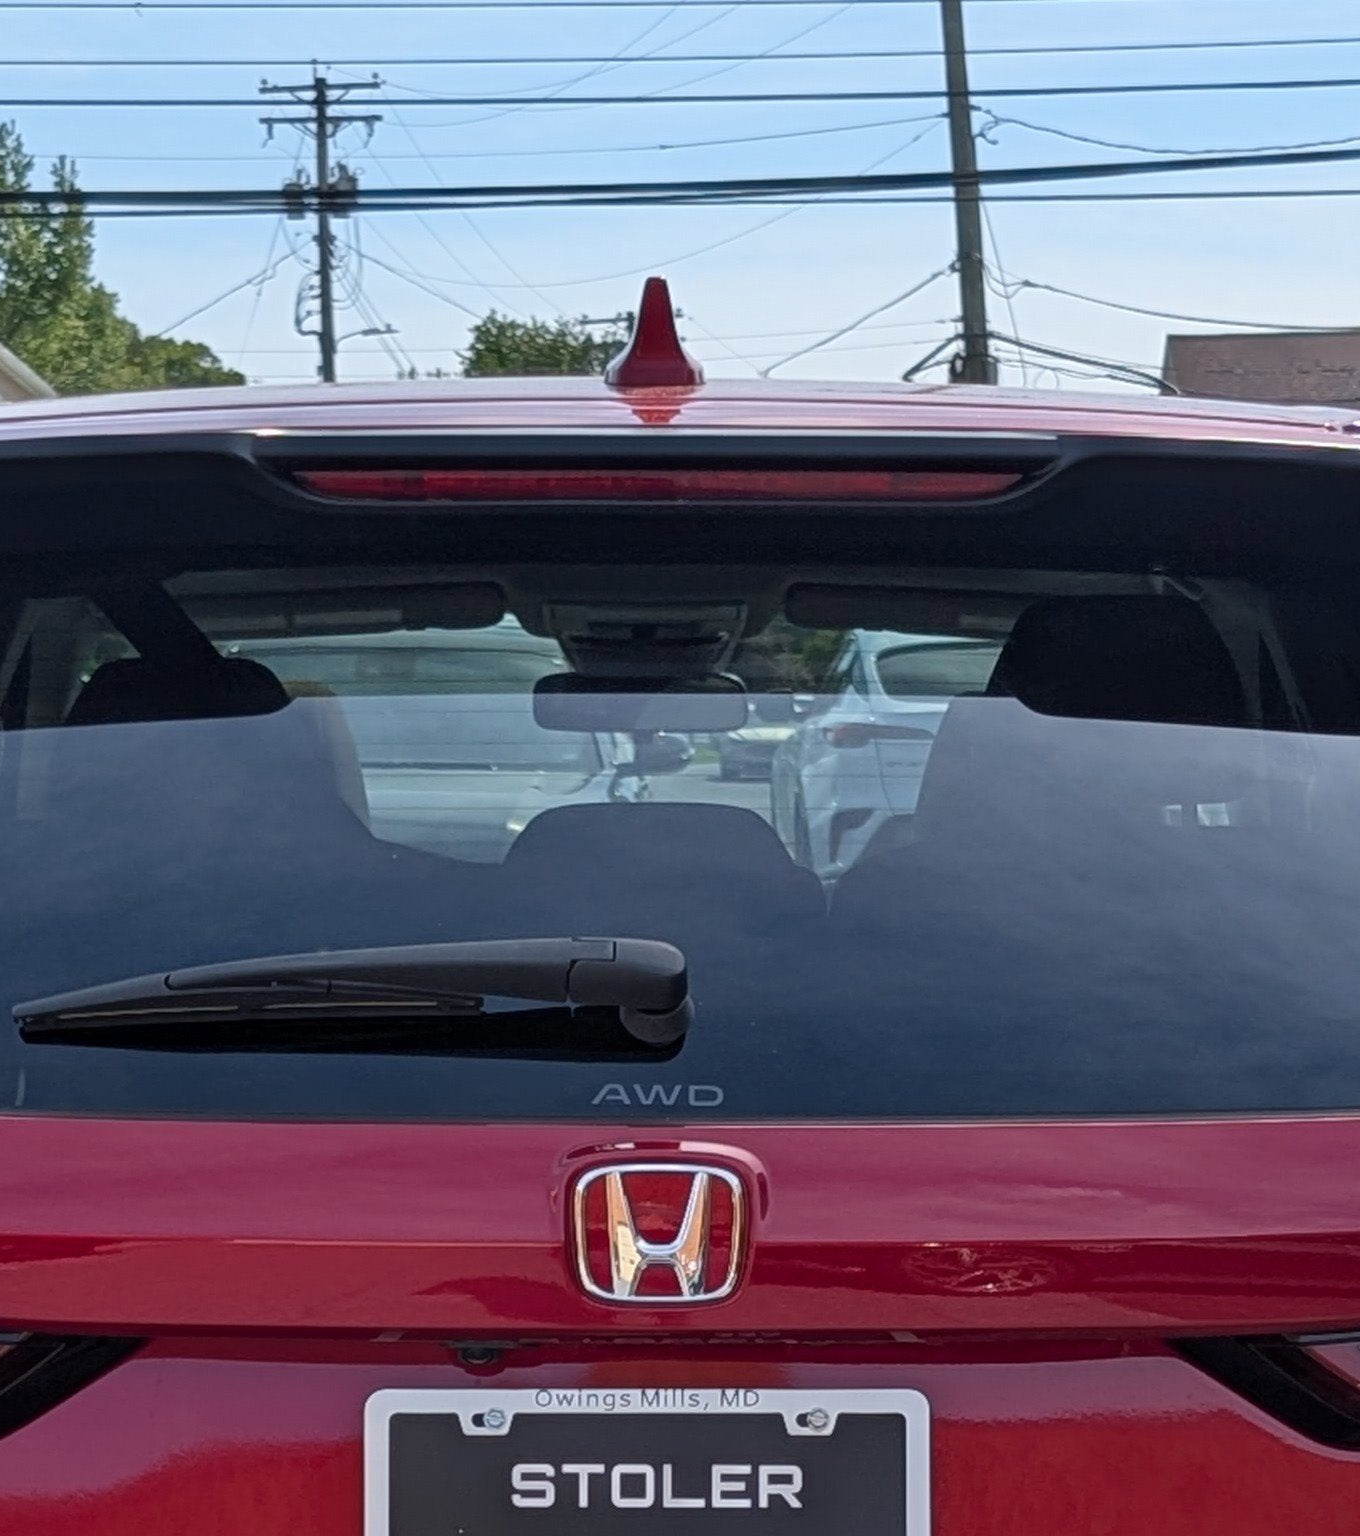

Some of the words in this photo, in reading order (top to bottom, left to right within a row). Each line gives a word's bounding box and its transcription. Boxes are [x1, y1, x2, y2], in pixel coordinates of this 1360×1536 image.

[591, 1083, 725, 1107] AWD
[535, 1389, 632, 1411] Owings
[640, 1389, 710, 1411] Mills,
[720, 1389, 761, 1408] MD
[510, 1462, 804, 1509] STOLER
